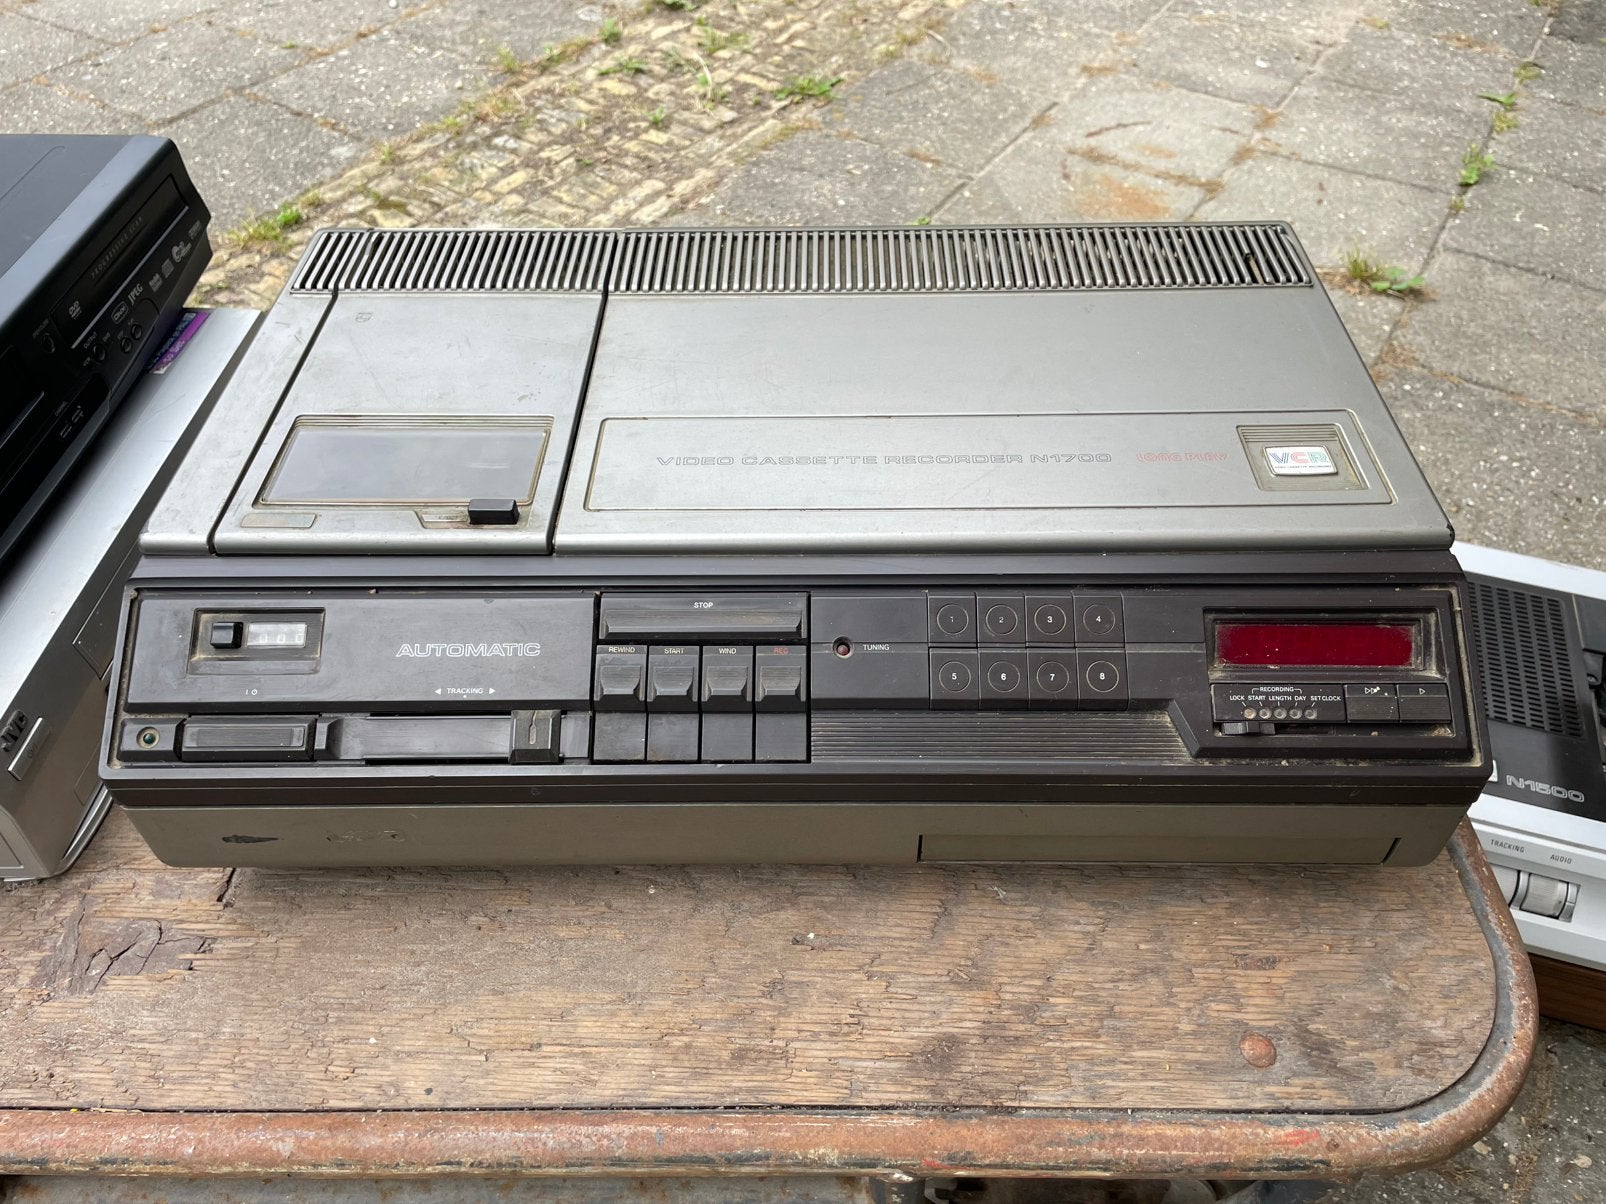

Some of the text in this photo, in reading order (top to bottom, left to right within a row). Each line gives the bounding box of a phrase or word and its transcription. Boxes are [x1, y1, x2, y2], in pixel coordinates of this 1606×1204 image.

[127, 283, 144, 306] JPEG
[656, 453, 1112, 466] VIDEO CASSETTE RECORDER N1700
[1184, 452, 1228, 462] PLAY
[1269, 451, 1329, 464] VCR
[694, 601, 714, 609] STOP
[395, 643, 541, 658] AUTOMATIC
[664, 647, 685, 655] START
[718, 647, 737, 655] WIND
[773, 647, 789, 655] REC
[862, 643, 890, 651] TUNING
[446, 687, 484, 695] TRACKING
[0, 710, 28, 753] JVC
[1506, 774, 1585, 803] N1500
[1490, 838, 1525, 854] TRACKING
[1550, 854, 1573, 865] AUDIO
